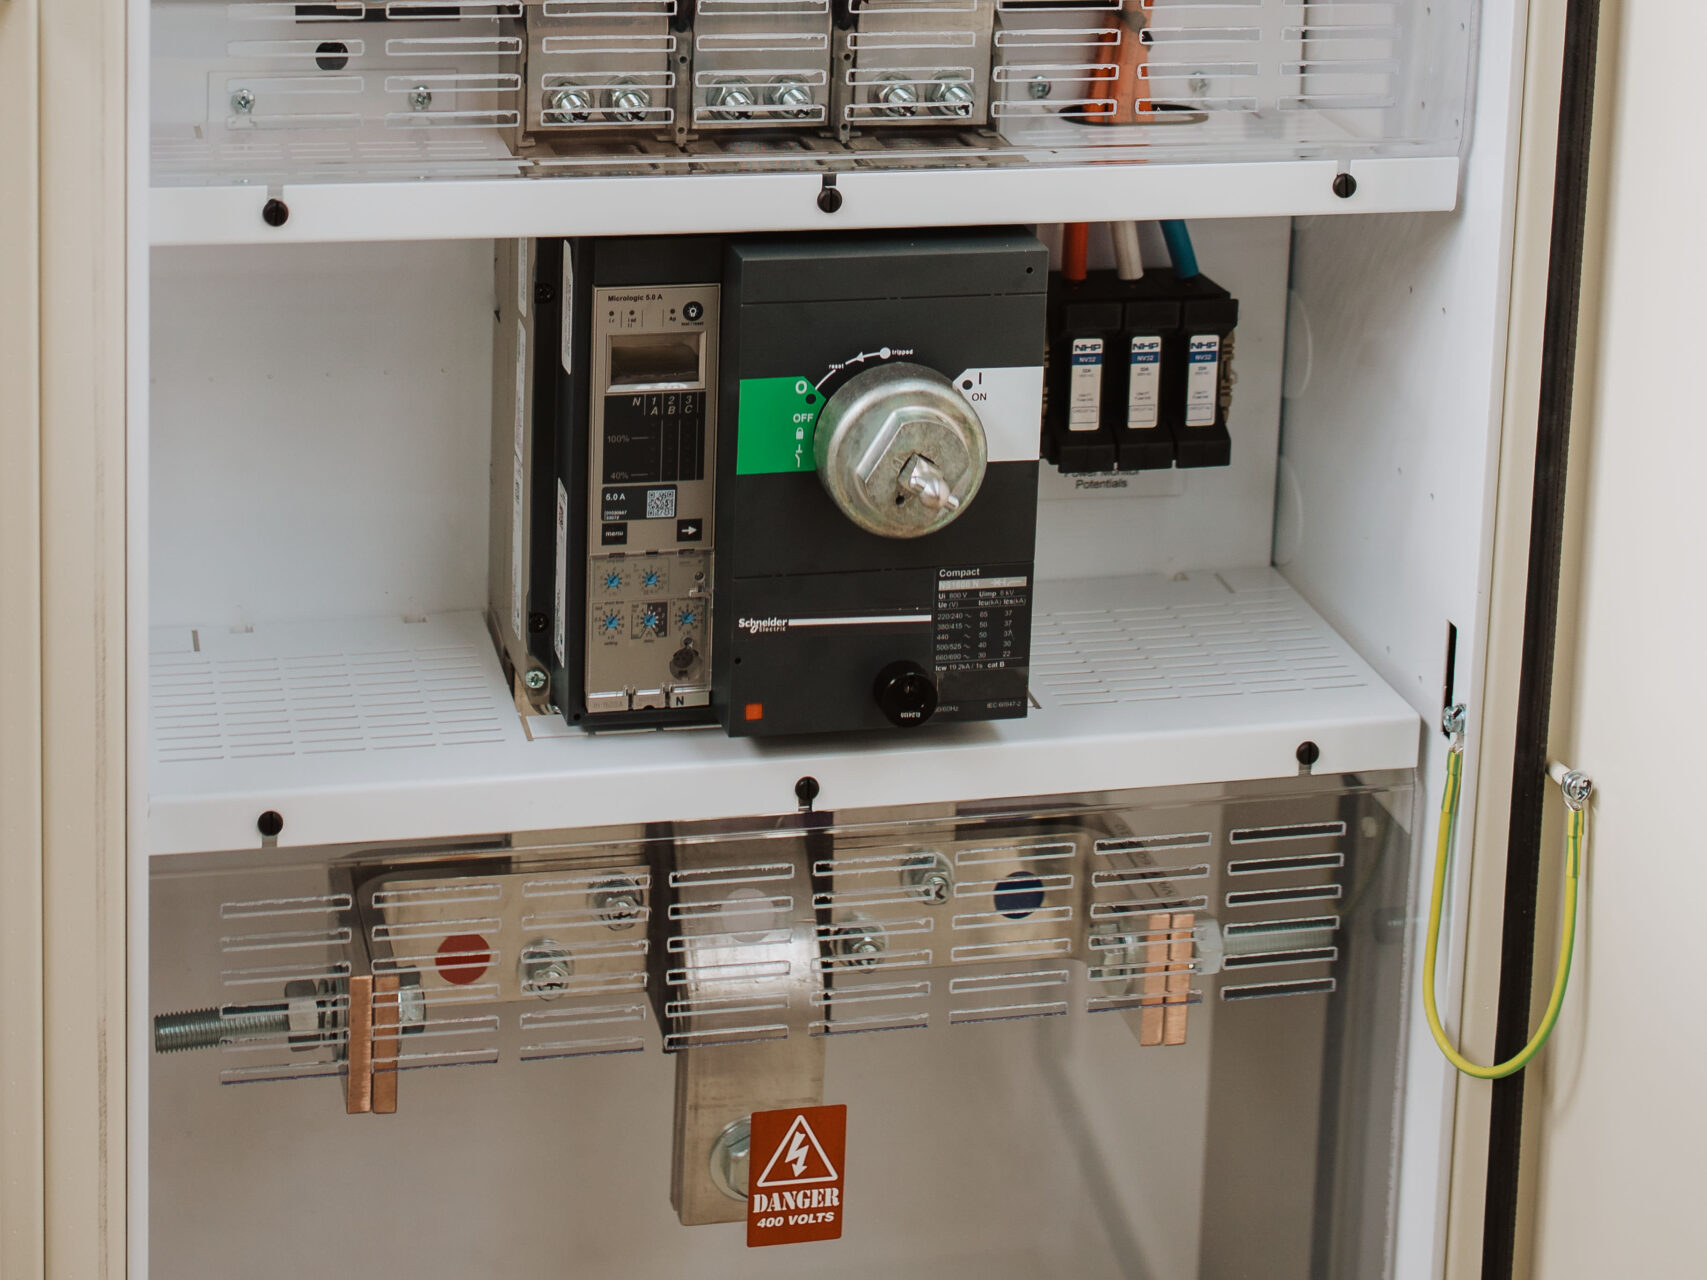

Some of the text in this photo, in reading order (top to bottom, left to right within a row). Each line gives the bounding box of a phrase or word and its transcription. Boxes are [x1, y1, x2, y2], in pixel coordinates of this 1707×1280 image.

[608, 293, 644, 303] Micrologic
[657, 293, 663, 301] A
[1074, 343, 1102, 352] NHP
[1132, 342, 1160, 351] NHP
[1190, 341, 1217, 350] NHP
[891, 348, 914, 356] tripped
[632, 396, 642, 407] N
[651, 396, 656, 406] 1
[667, 395, 675, 405] 2
[685, 395, 693, 405] 3
[971, 392, 987, 402] ON
[650, 407, 659, 415] A
[667, 406, 676, 415] B
[684, 405, 693, 414] C
[793, 413, 814, 423] OFF
[607, 434, 630, 443] 100%
[611, 471, 629, 480] 40%
[1075, 479, 1128, 490] Potentials
[619, 493, 626, 501] A
[939, 568, 980, 578] Compact
[738, 617, 788, 630] Schneider
[675, 696, 685, 706] N
[753, 1187, 840, 1213] DANGER
[756, 1211, 835, 1228] 400 VOLTS
